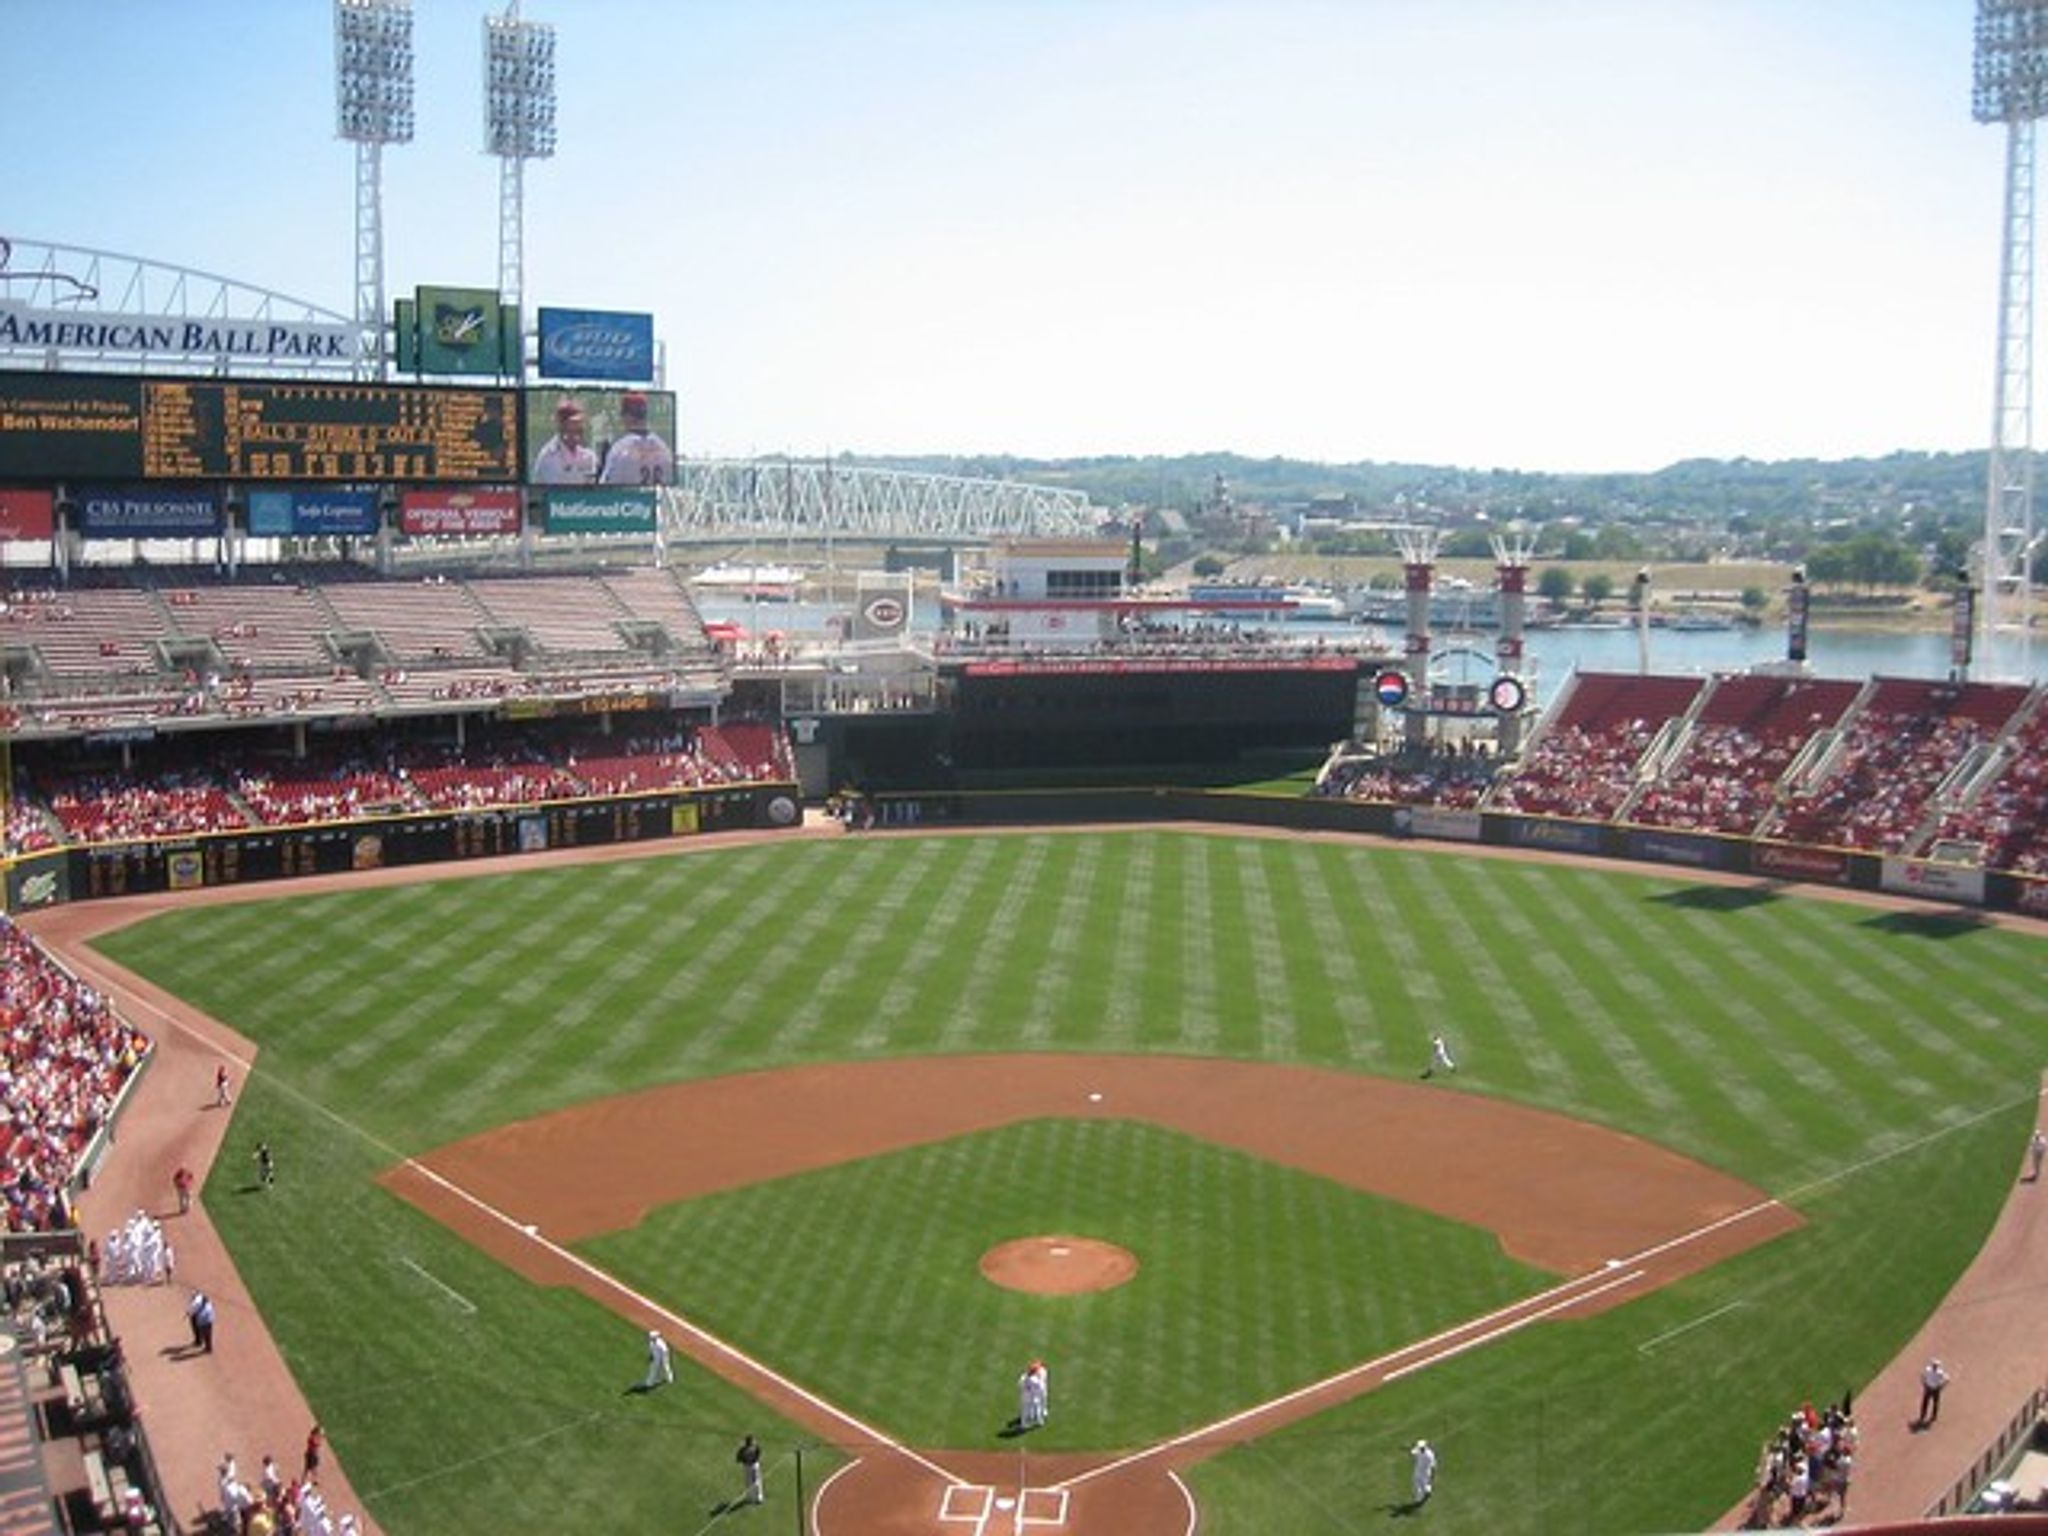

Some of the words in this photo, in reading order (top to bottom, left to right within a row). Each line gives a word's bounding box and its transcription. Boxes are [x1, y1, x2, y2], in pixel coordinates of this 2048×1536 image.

[0, 313, 174, 350] AMERICAN
[181, 323, 260, 352] BALL
[265, 327, 346, 356] PARK
[550, 499, 619, 518] National
[620, 501, 651, 520] City
